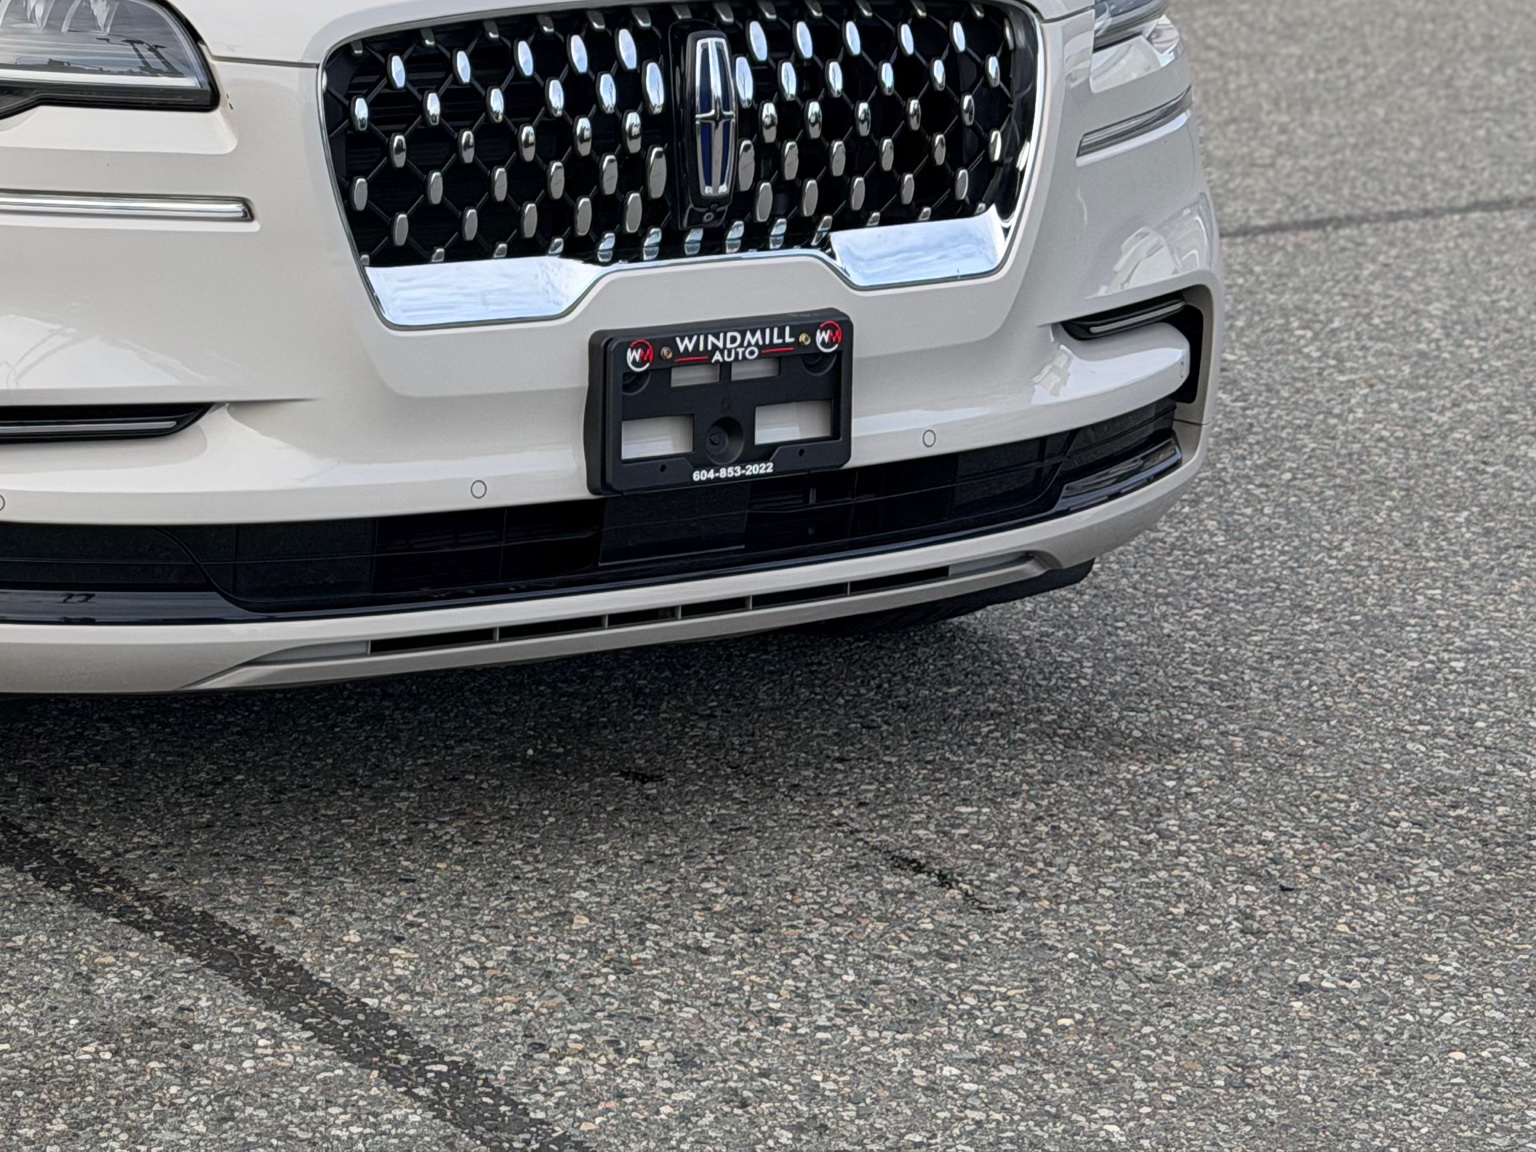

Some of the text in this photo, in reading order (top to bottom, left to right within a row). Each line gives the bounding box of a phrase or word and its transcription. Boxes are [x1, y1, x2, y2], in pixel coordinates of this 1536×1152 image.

[675, 326, 795, 353] WINDMILL
[711, 346, 759, 364] AUTO
[692, 462, 774, 482] 604-853-2022
